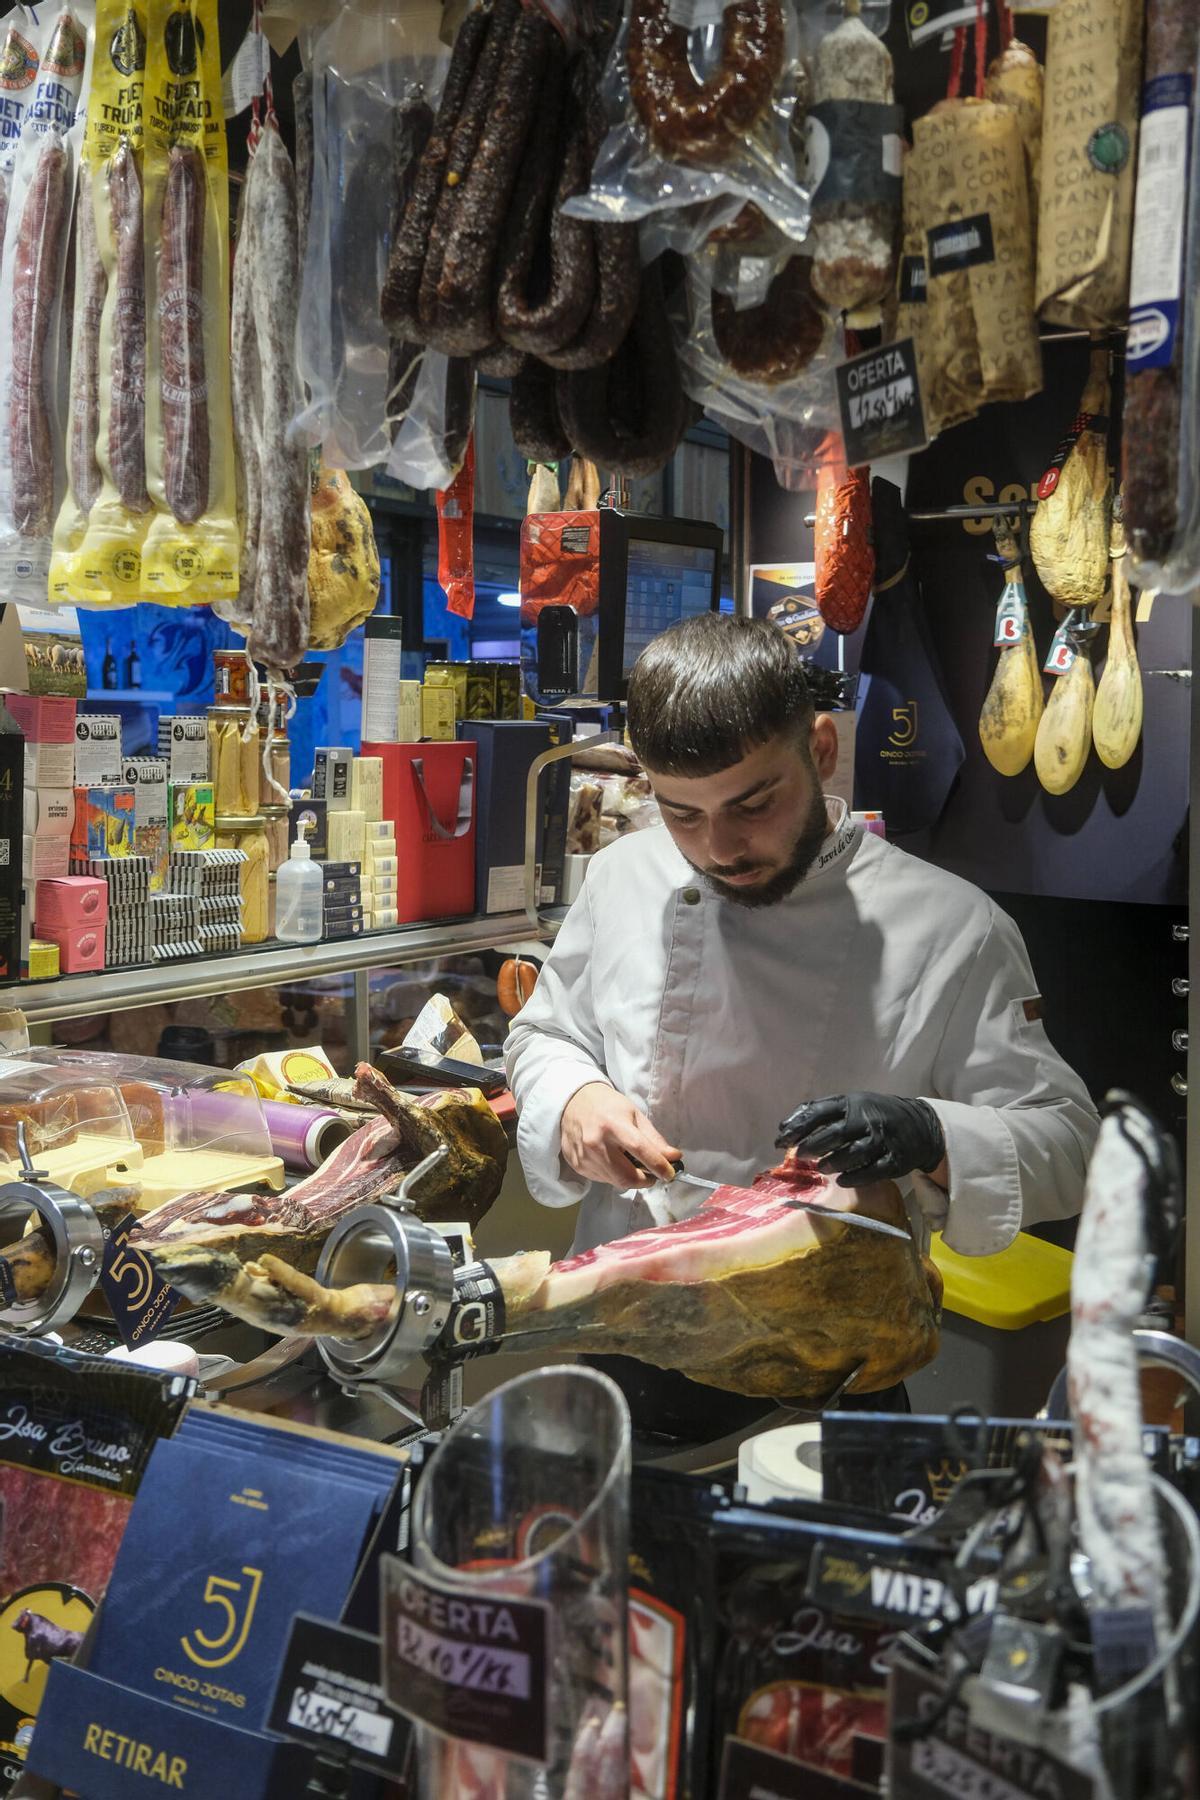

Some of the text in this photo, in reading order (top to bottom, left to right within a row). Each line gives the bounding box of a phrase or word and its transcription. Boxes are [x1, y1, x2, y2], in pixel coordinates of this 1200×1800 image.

[37, 82, 72, 107] FUET
[847, 350, 906, 391] OFERTA
[132, 1283, 173, 1341] CINCO JOTA
[180, 1565, 263, 1668] 5J
[400, 1578, 519, 1641] OFERTA
[154, 1666, 199, 1692] CINCO
[200, 1682, 246, 1708] JOTAS
[83, 1722, 188, 1789] RETIRAR
